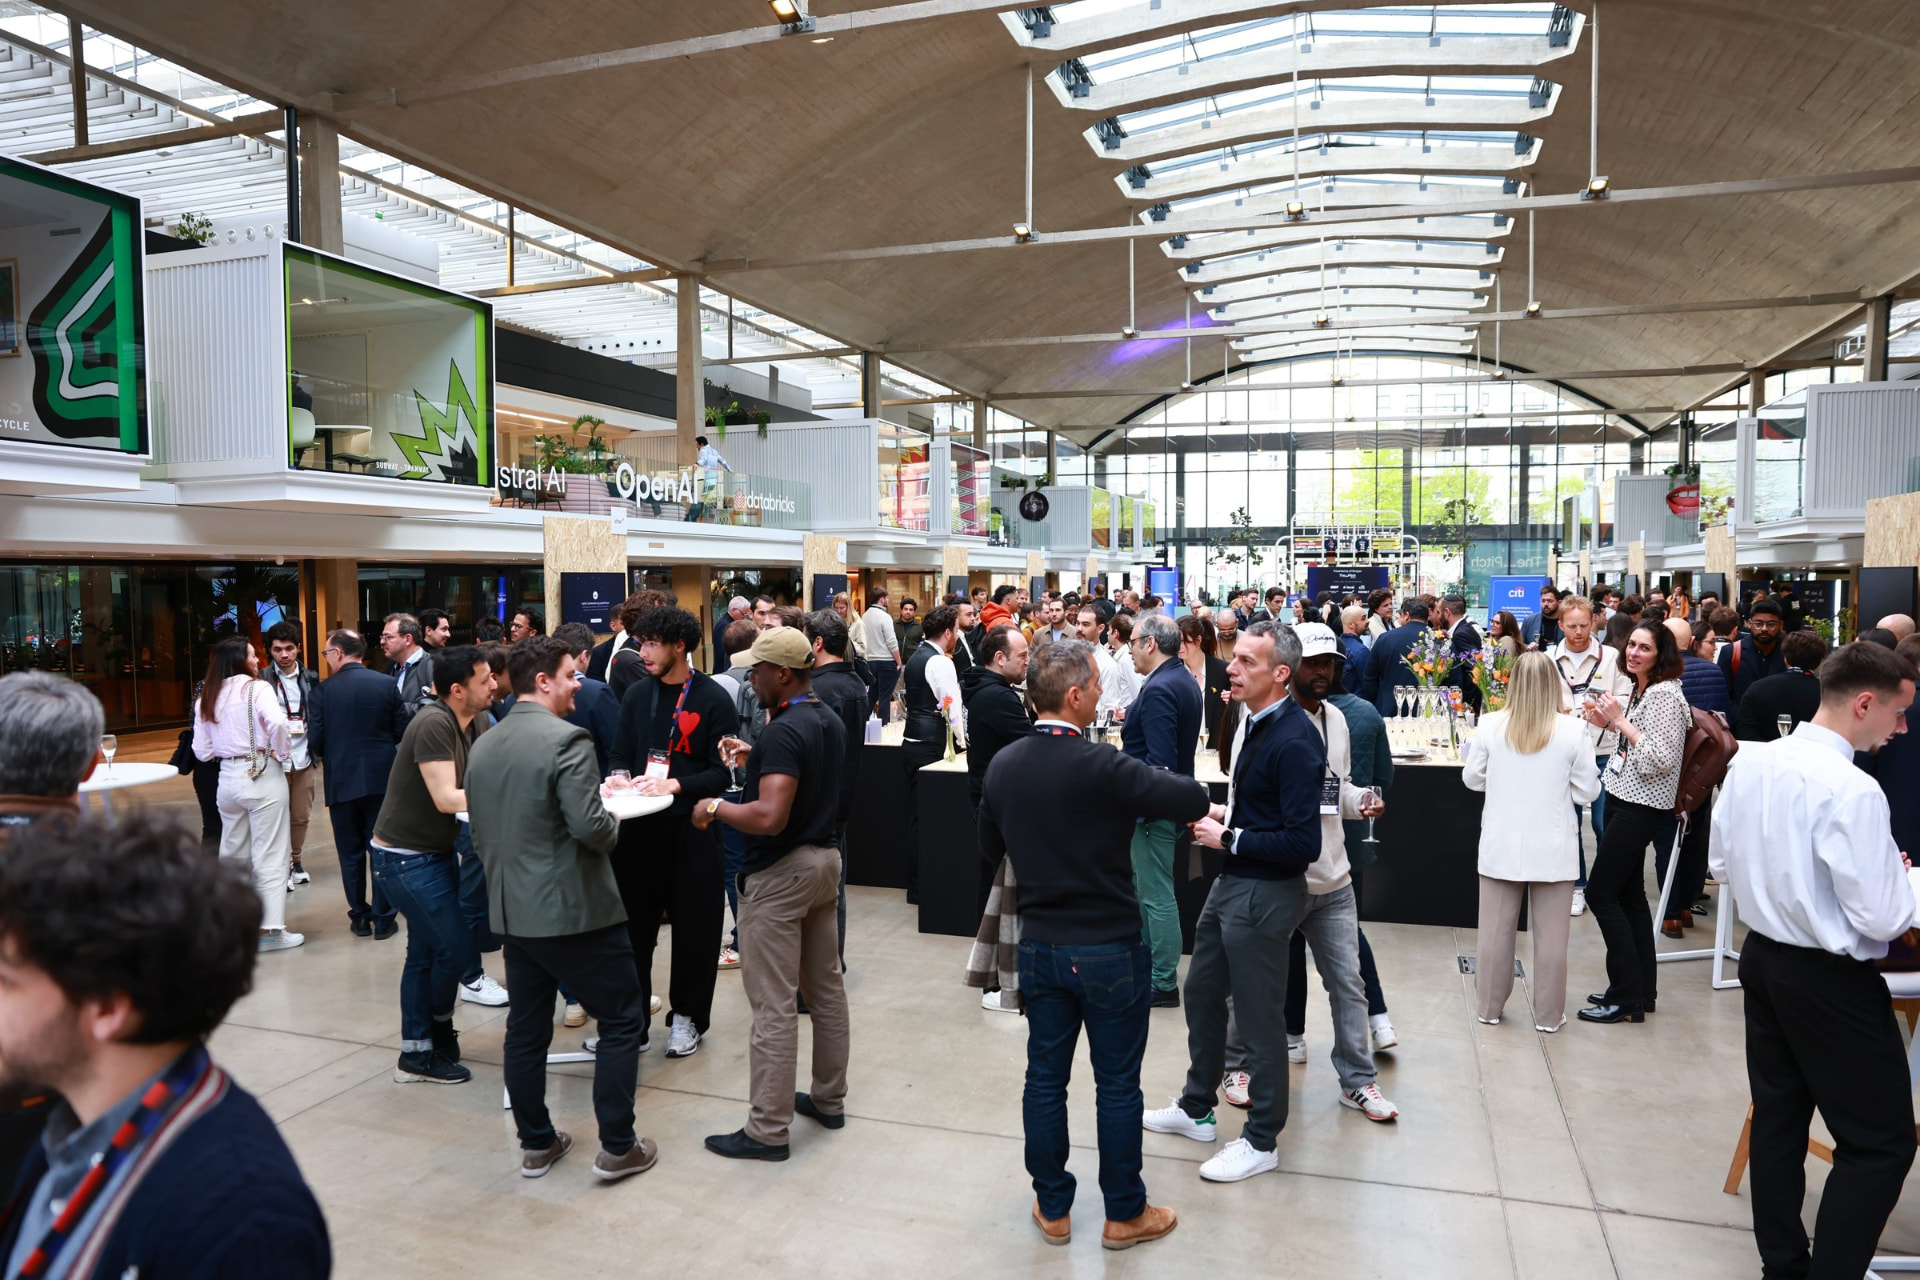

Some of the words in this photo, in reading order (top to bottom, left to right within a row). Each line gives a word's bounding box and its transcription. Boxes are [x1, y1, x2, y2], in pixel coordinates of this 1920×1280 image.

[546, 465, 566, 493] AI
[616, 462, 699, 508] OpenAI
[746, 490, 796, 514] databricks
[1508, 587, 1525, 598] citi
